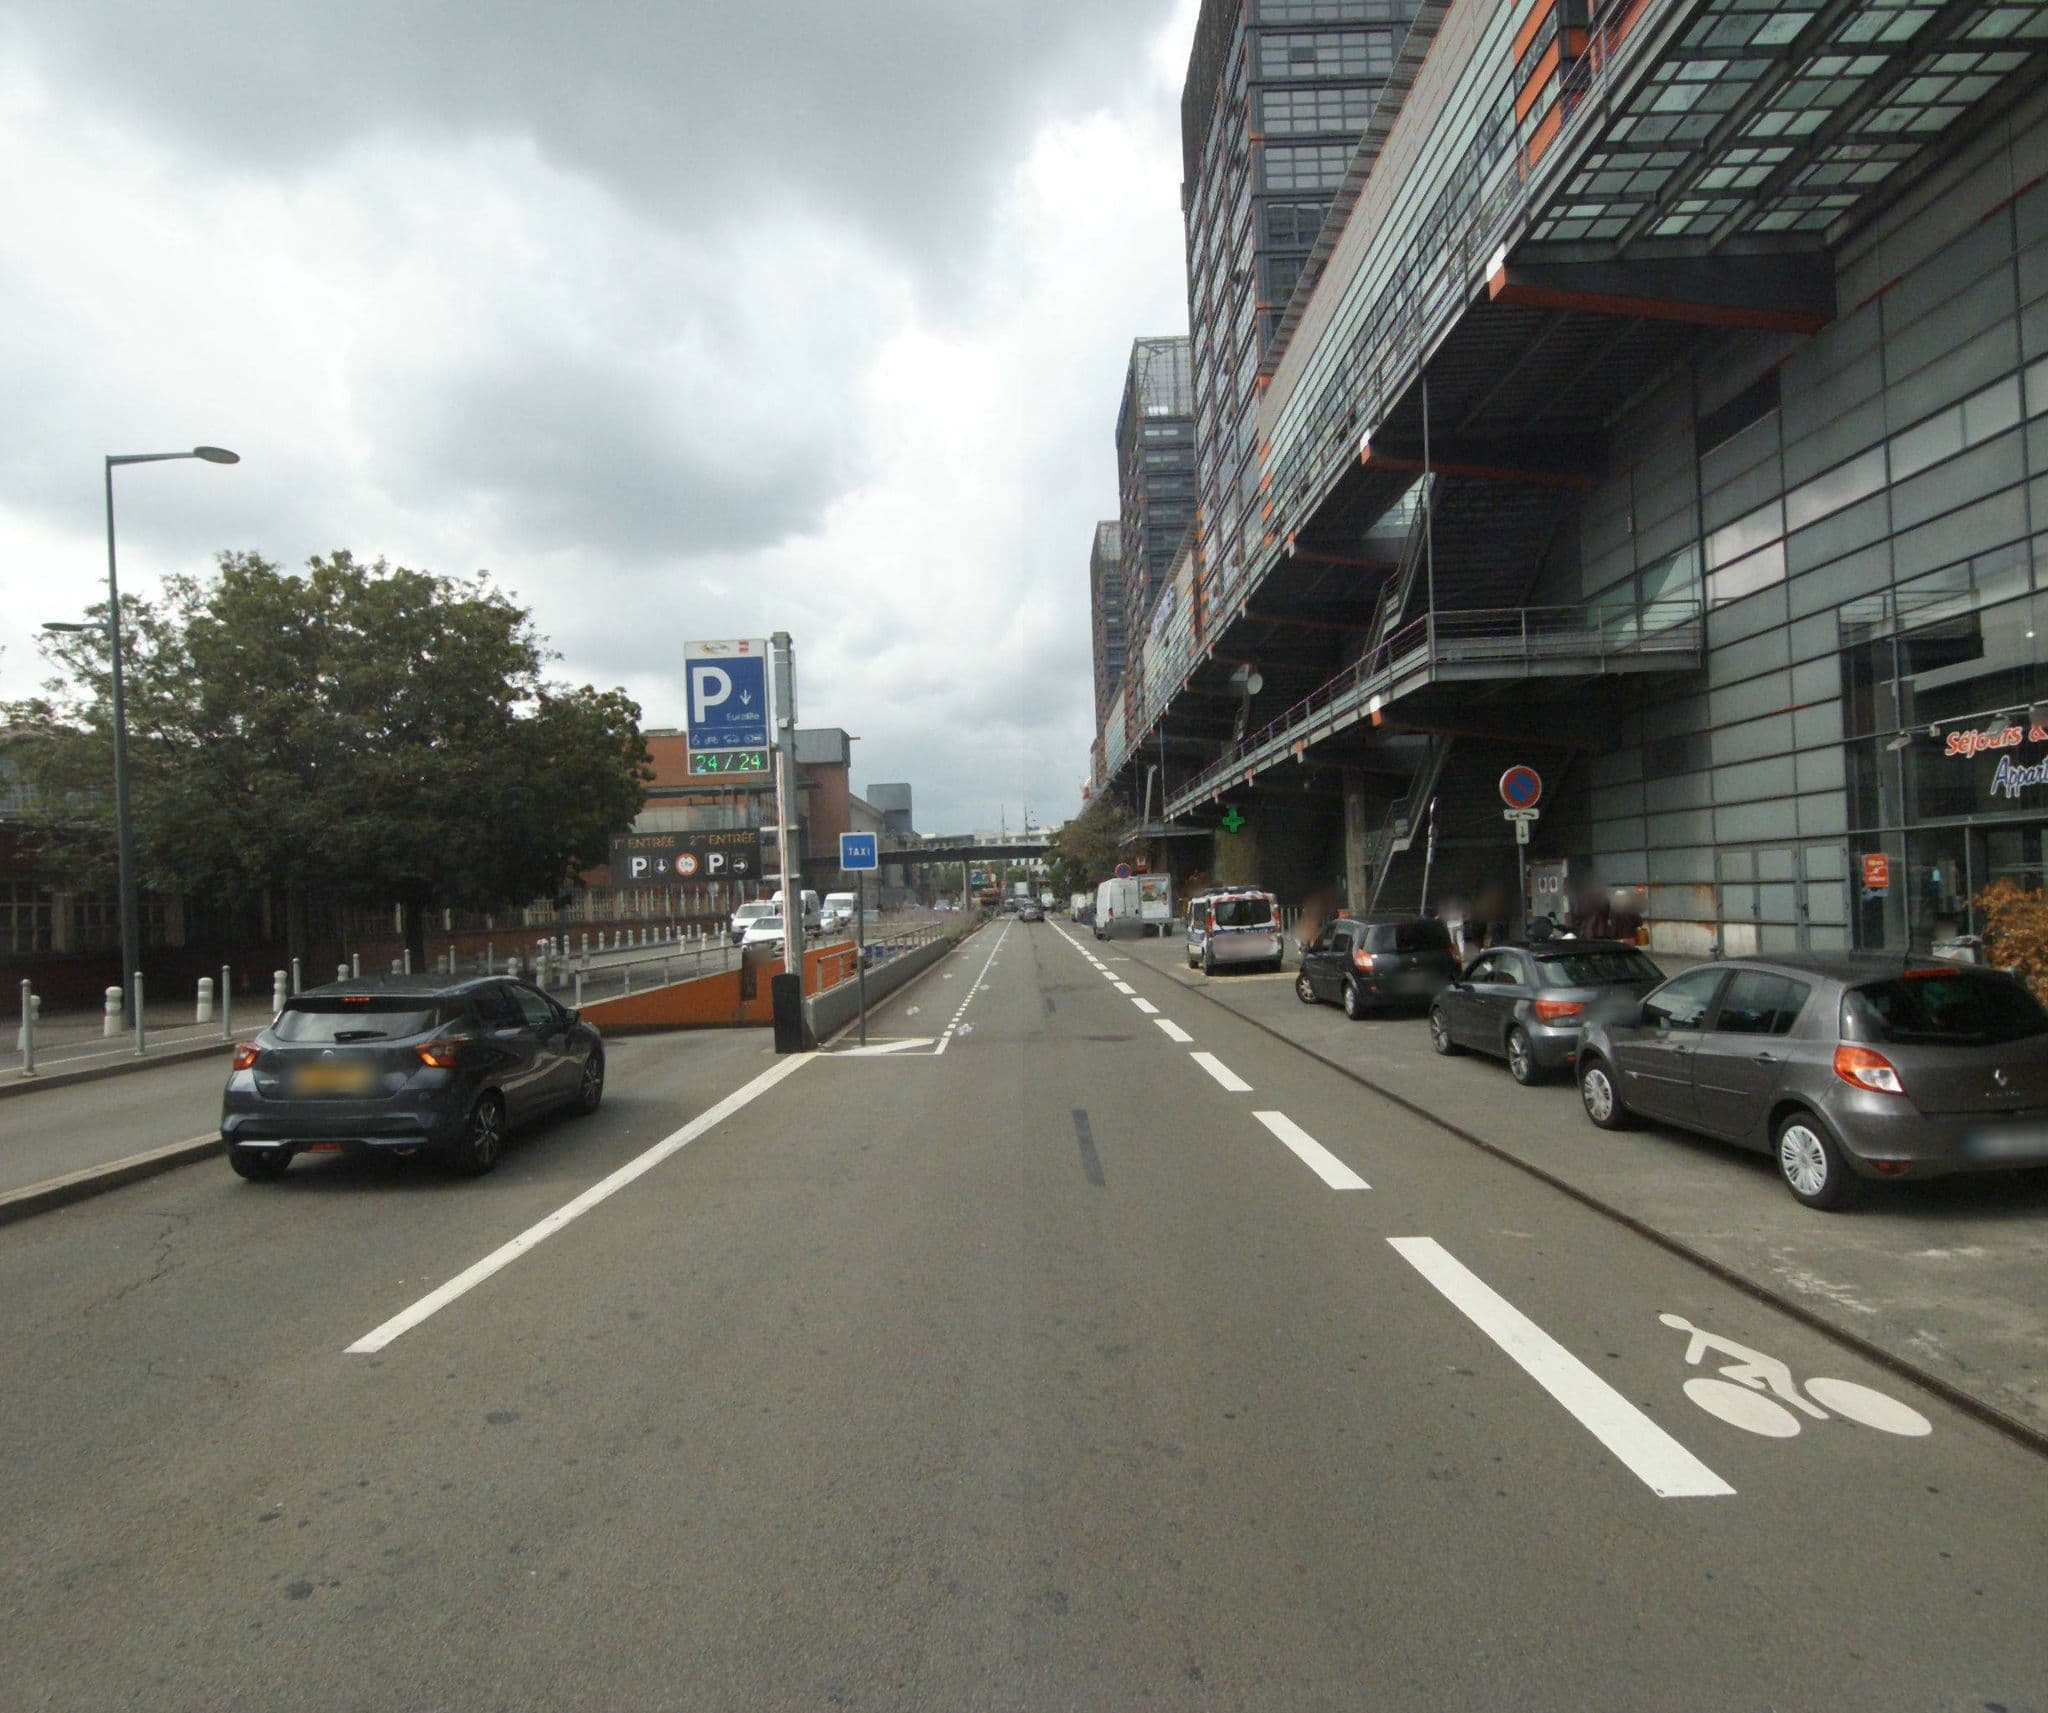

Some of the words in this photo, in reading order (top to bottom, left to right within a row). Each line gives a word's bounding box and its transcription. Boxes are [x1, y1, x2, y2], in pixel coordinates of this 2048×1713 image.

[692, 666, 732, 723] P
[1944, 726, 2023, 759] Séjours
[848, 847, 871, 857] TAXI
[631, 857, 648, 878] P
[708, 854, 724, 874] P
